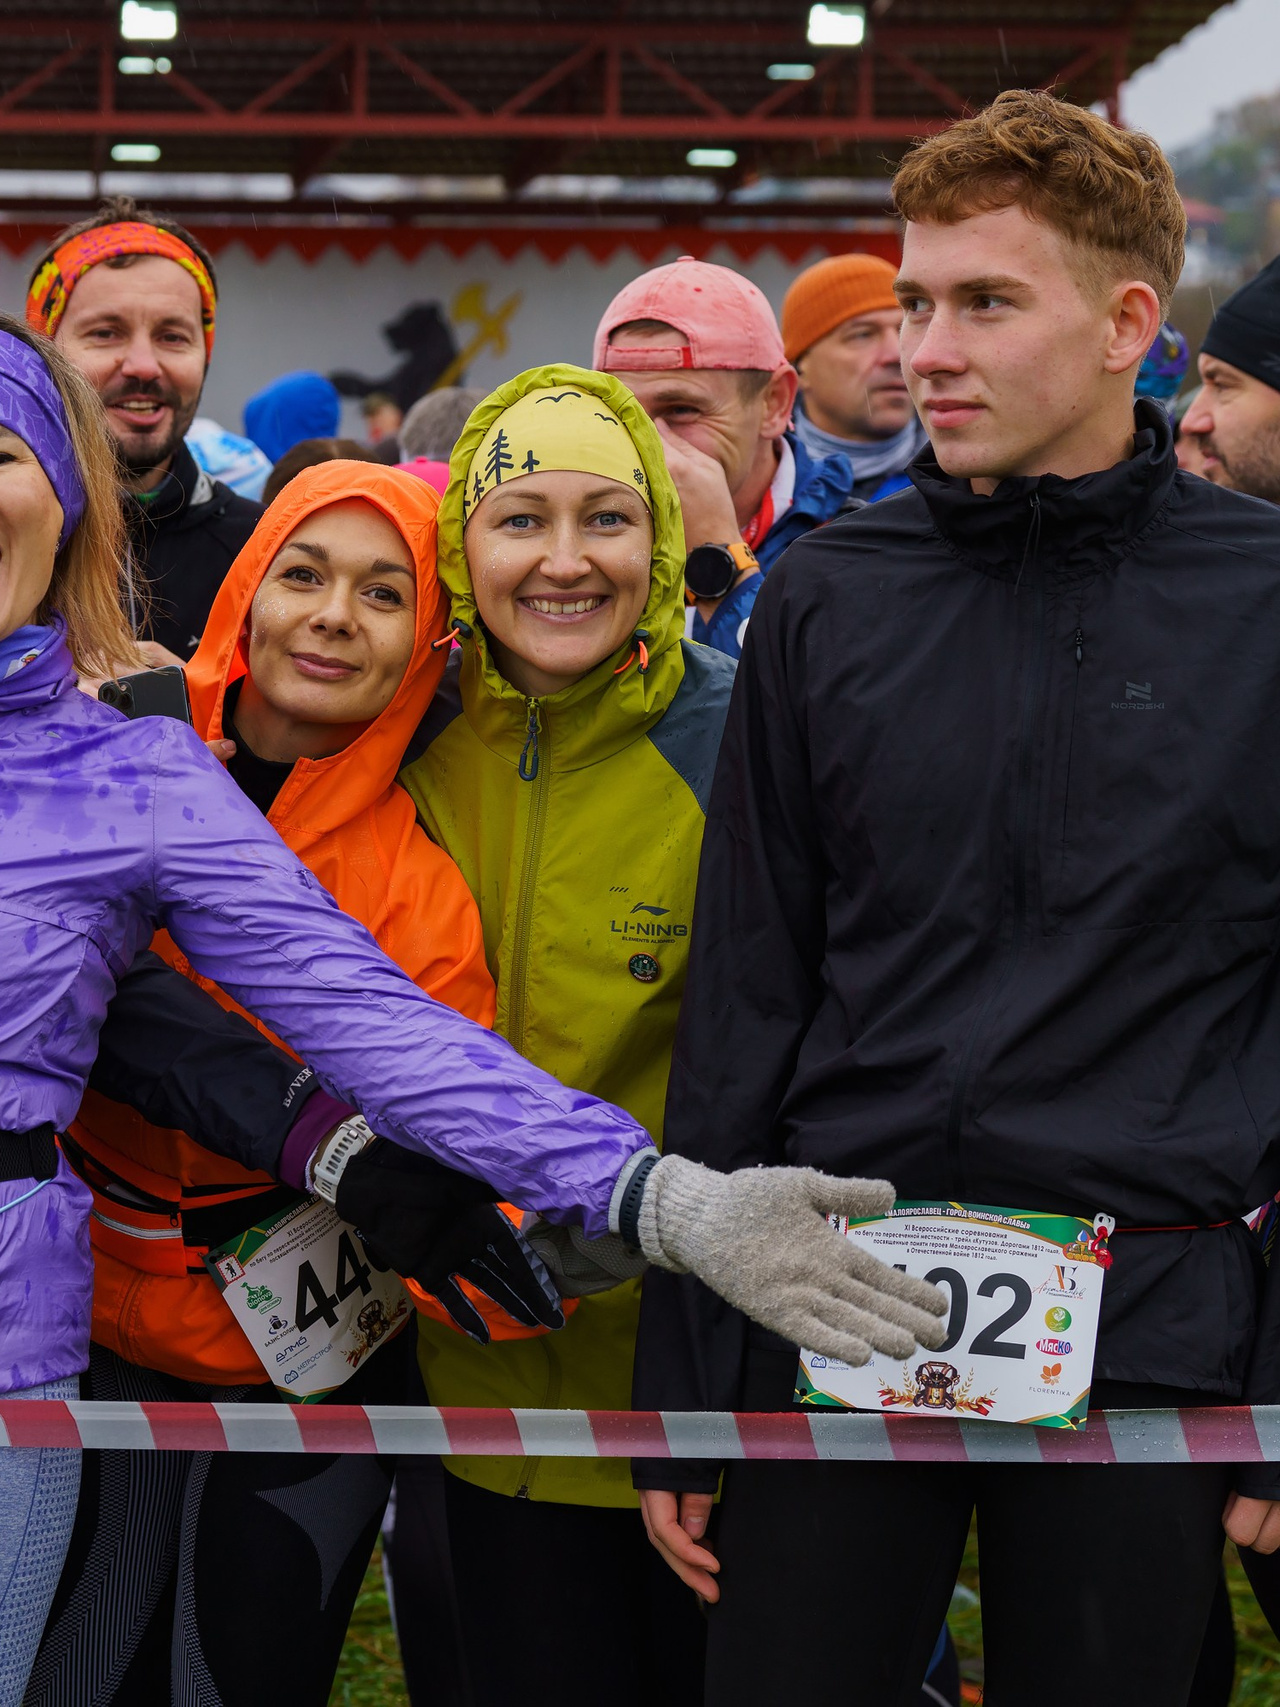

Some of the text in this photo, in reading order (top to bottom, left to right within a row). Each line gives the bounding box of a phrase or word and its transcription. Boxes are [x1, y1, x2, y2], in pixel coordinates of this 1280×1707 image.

[1111, 702, 1165, 710] NORDSKI
[610, 920, 688, 936] LI-NING
[292, 1206, 329, 1232] Всероссийские
[946, 1208, 967, 1218] ГОРОД
[968, 1210, 1002, 1223] ВОИНСКОЙ
[1002, 1217, 1030, 1229] СЛАВЫ»
[912, 1225, 959, 1234] Всероссийские
[961, 1229, 1008, 1239] соревнования
[949, 1243, 1007, 1254] Малоярославецкого
[1009, 1250, 1038, 1258] сражения
[1001, 1241, 1030, 1249] Дорогами
[295, 1230, 372, 1333] 44
[248, 1291, 272, 1307] bionova
[893, 1264, 1032, 1360] 02
[264, 1325, 297, 1347] БАЗИС ХОЛДИ
[297, 1343, 333, 1371] МЕТРОСТРОЙ
[1028, 1387, 1071, 1396] FLORENTIKA
